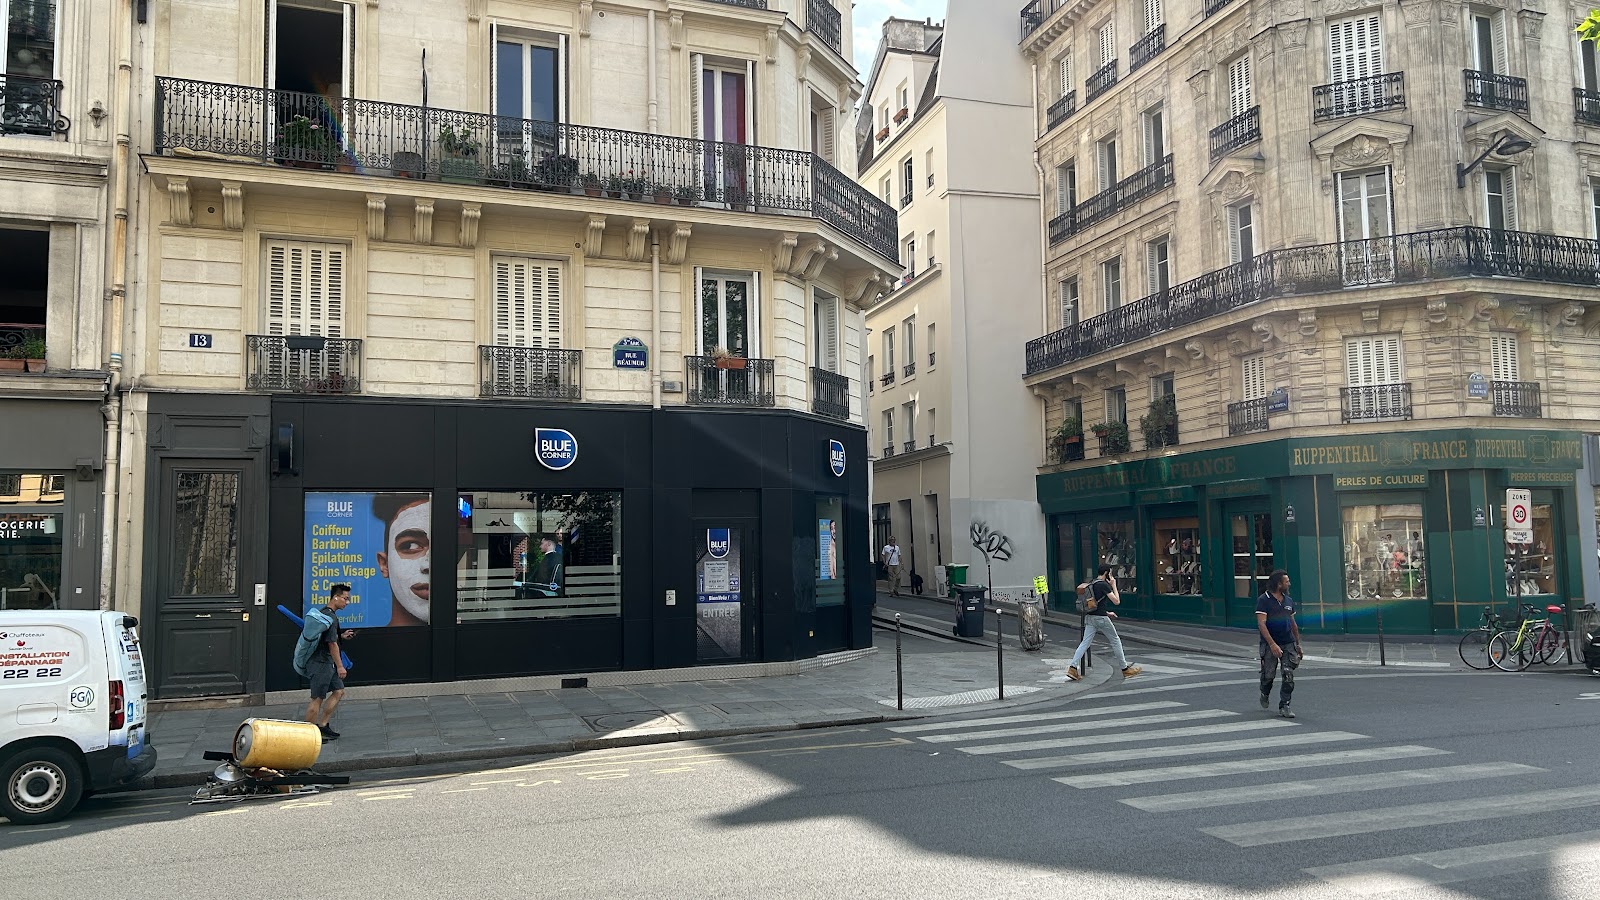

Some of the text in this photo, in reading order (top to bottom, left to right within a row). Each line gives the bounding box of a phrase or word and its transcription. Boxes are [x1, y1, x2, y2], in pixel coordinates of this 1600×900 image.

[194, 335, 207, 346] 13
[617, 358, 644, 366] RÉAUMUR
[541, 440, 571, 451] BLUE
[1475, 439, 1581, 458] RUPPENTHAL FRANCE
[831, 450, 844, 462] BLUE
[1294, 440, 1468, 466] RUPPENTHAL FRANCE
[1064, 467, 1146, 493] RUPPENTHAL
[1170, 456, 1236, 480] FRANCE
[1336, 474, 1425, 486] PERLES DE CULTURE
[1510, 472, 1536, 482] PIERRES
[327, 501, 353, 512] BLUE
[1515, 510, 1524, 518] 30
[312, 524, 352, 536] Coiffeur
[312, 538, 350, 549] Barbier
[312, 552, 362, 566] Epilations
[312, 565, 376, 579] Soins Visage
[311, 579, 319, 591] &
[703, 605, 735, 618] ENTRÉE
[3, 667, 62, 679] 22 22
